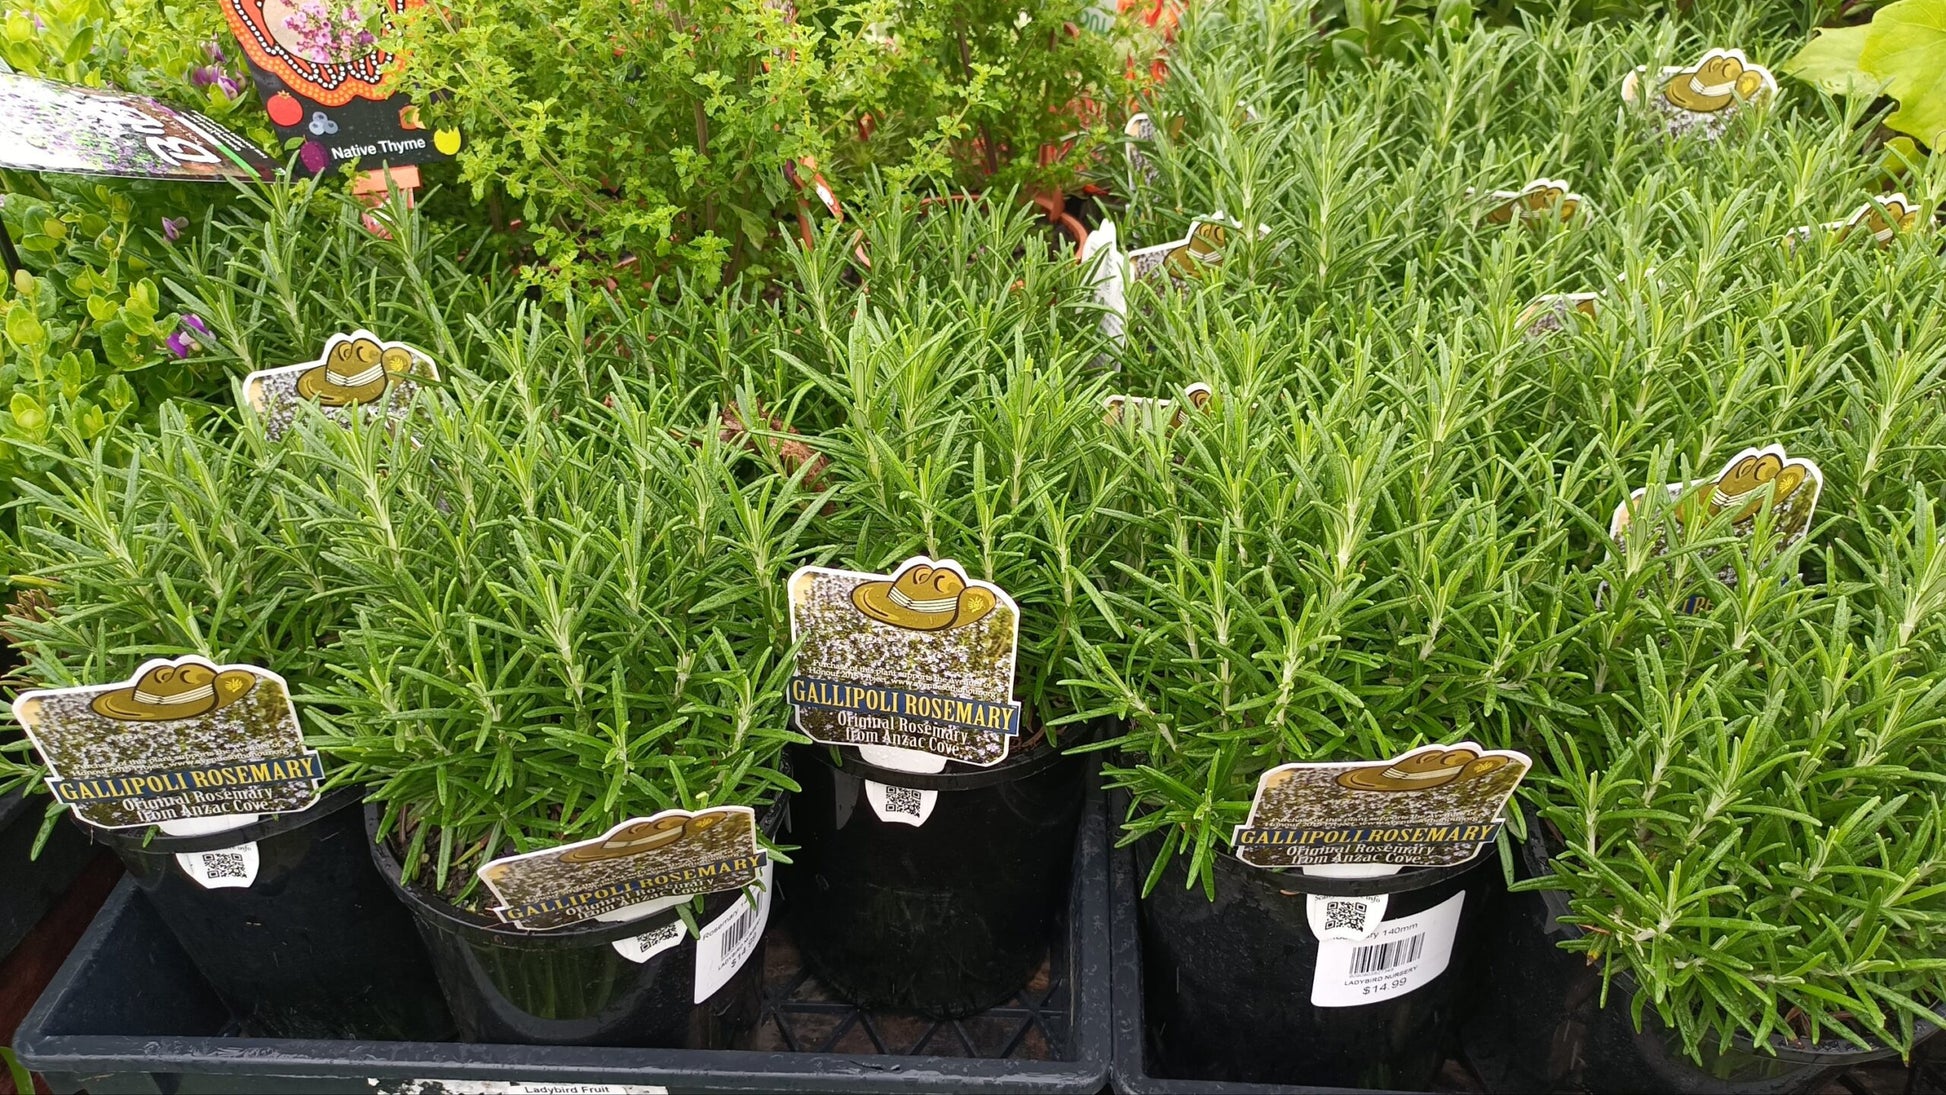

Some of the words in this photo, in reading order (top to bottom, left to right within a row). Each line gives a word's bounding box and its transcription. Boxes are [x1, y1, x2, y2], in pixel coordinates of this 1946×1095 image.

[331, 144, 376, 160] Native
[378, 137, 426, 154] Thyme
[792, 679, 899, 713] GALLIPOLI
[904, 693, 1015, 731] ROSEMARY
[838, 710, 894, 730] Original
[899, 716, 968, 745] Rosemary
[846, 726, 879, 743] from
[882, 729, 926, 749] Anzac
[929, 736, 960, 756] Cove
[59, 772, 189, 800] GALLIPOLI
[191, 757, 314, 790] ROSEMARY
[122, 792, 190, 812] Original
[192, 787, 273, 804] Rosemary
[137, 808, 178, 822] from
[181, 801, 230, 817] Anzac
[234, 799, 270, 813] Cove
[1240, 829, 1366, 845] GALLIPOLI
[1367, 824, 1496, 842] ROSEMARY
[1286, 844, 1351, 857] Original
[1355, 843, 1436, 855] Rosemary
[1291, 855, 1329, 865] from
[1332, 852, 1382, 864] Anzac
[1385, 852, 1422, 864] Cove
[506, 883, 632, 919] GALLIPOLI
[640, 855, 760, 888] ROSEMARY
[565, 892, 632, 916] Original
[636, 878, 714, 897] Rosemary
[577, 904, 615, 920] from
[620, 891, 668, 906] Anzac
[672, 885, 708, 896] Cove
[1383, 922, 1418, 937] 140mm
[1344, 975, 1383, 986] LADYBIRD
[1384, 965, 1418, 980] NURSERY
[1362, 976, 1407, 995] $14.99
[525, 1086, 578, 1095] Ladybird
[581, 1086, 610, 1094] Fruit
